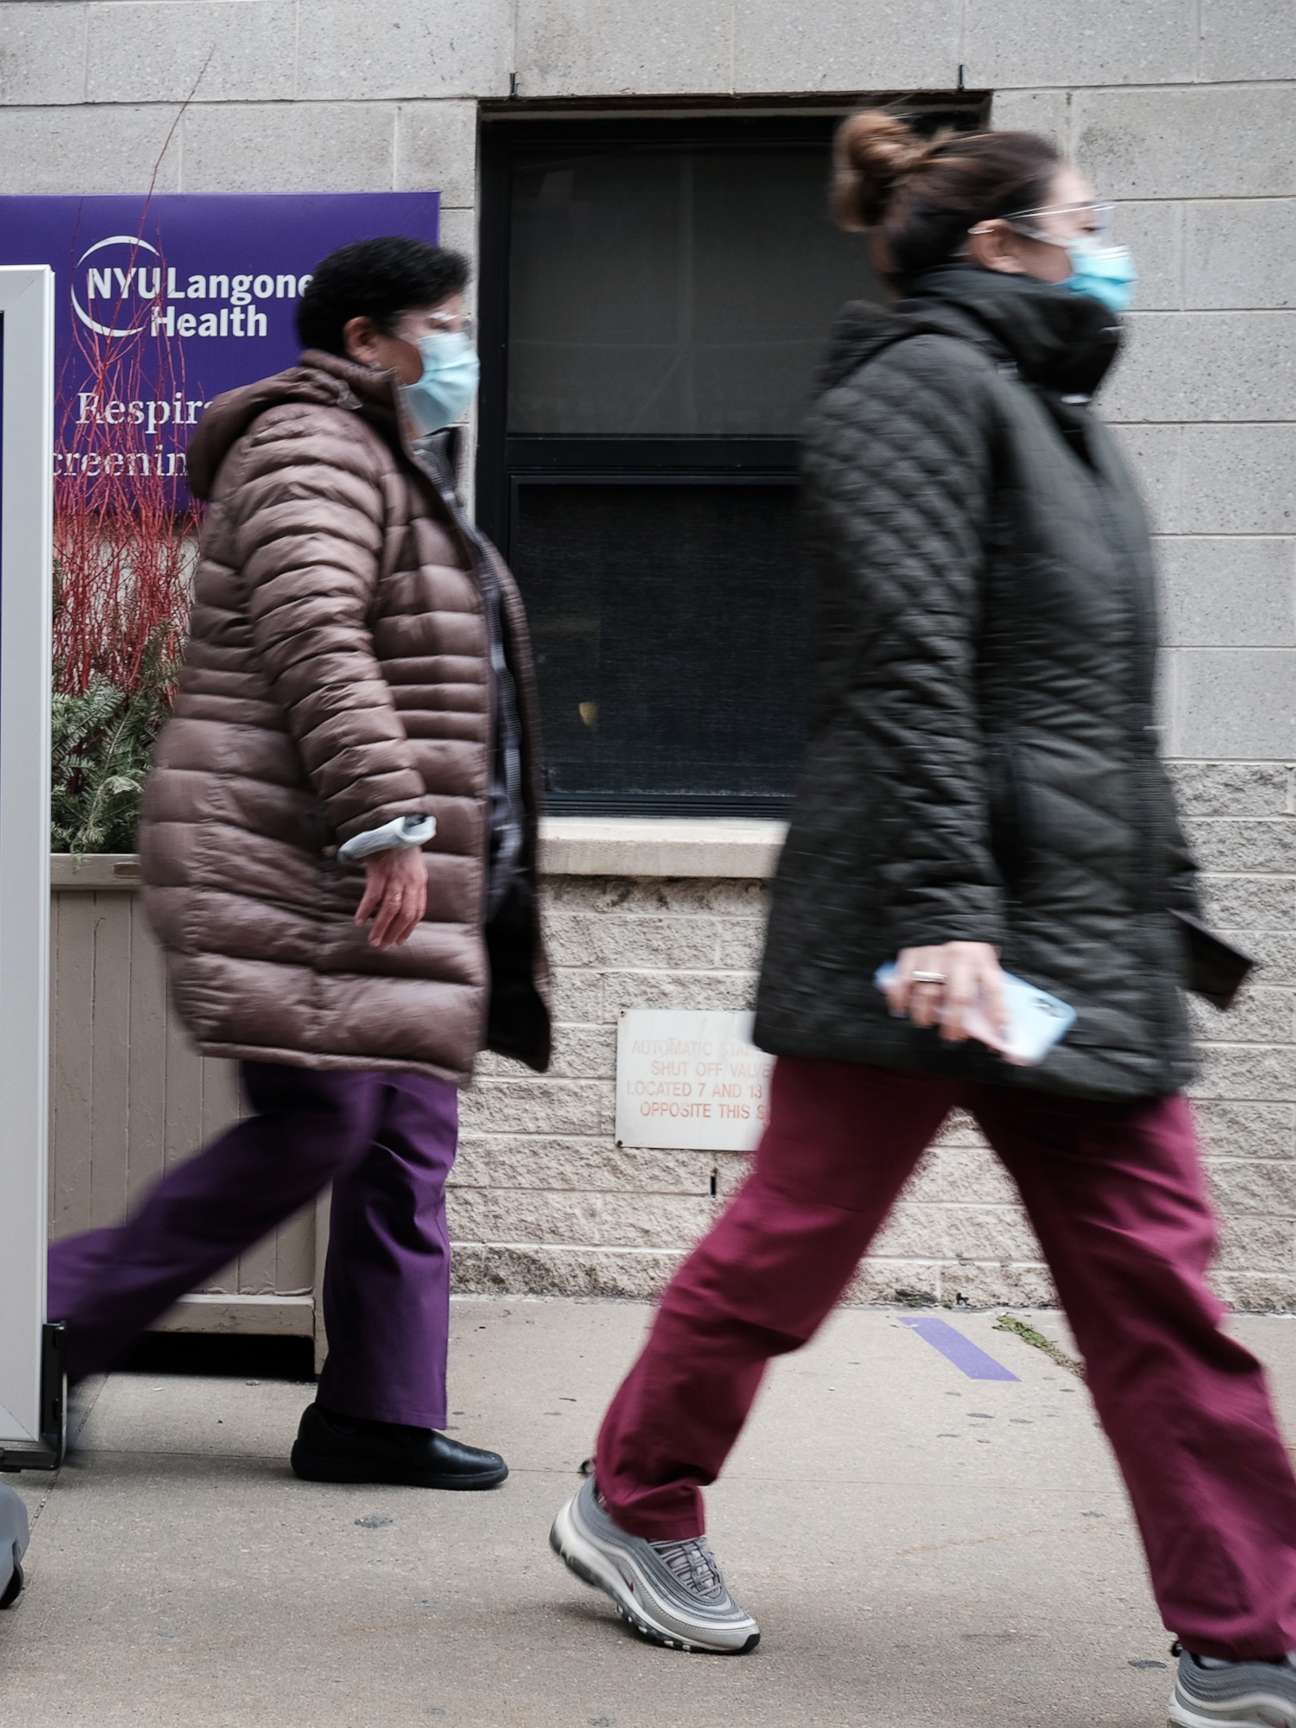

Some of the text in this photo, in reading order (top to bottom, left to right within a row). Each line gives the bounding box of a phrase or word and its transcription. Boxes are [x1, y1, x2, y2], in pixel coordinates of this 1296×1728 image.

[88, 267, 161, 299] NYU
[151, 304, 267, 337] Health
[75, 391, 212, 434] Respir
[632, 1040, 713, 1056] AUTOMATIC
[651, 1061, 688, 1077] SHUT
[696, 1062, 724, 1077] OFF
[626, 1080, 692, 1097] LOCATED
[698, 1082, 707, 1097] 7
[712, 1083, 742, 1099] AND
[640, 1102, 712, 1118] OPPOSITE
[719, 1103, 751, 1119] THIS
